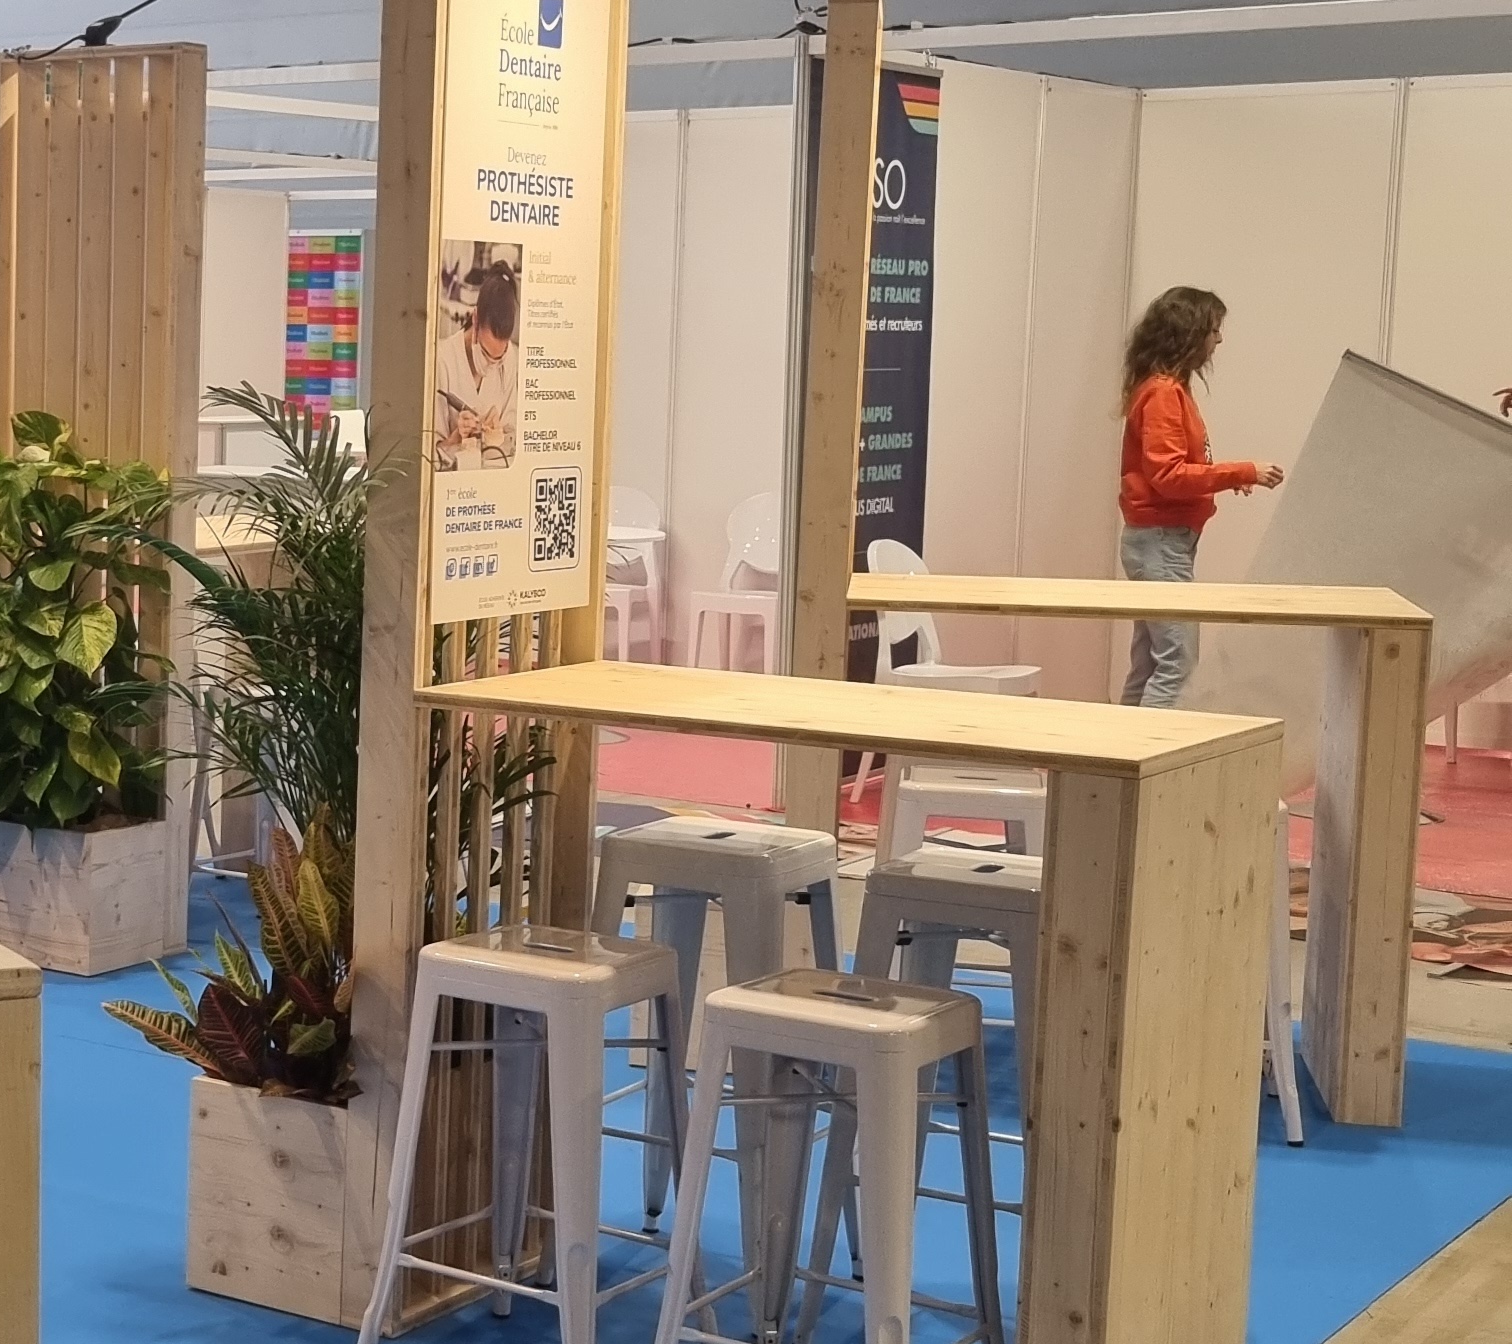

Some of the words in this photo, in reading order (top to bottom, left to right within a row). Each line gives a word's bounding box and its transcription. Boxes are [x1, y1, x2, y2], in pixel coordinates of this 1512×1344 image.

[500, 13, 534, 46] École
[499, 48, 561, 81] Dentaire
[497, 82, 560, 118] Française
[507, 146, 547, 166] Devenez
[477, 167, 574, 199] PROTHÉSISTE
[490, 200, 560, 227] DENTAIRE
[870, 254, 905, 275] RÉSEAU
[908, 259, 929, 276] PRO
[869, 286, 882, 303] DE
[884, 286, 922, 304] FRANCE
[526, 346, 544, 356] TITRE
[526, 358, 577, 369] PROFESSIONNEL
[525, 378, 539, 389] BAC
[524, 390, 576, 401] PROFESSIONNEL
[524, 410, 537, 421] BTS
[868, 432, 913, 451] GRANDES
[866, 463, 902, 482] FRANCE
[445, 506, 456, 517] DE
[457, 501, 496, 517] PROTHÈSE
[866, 496, 894, 515] DIGITAL
[445, 520, 482, 534] DENTAIRE
[483, 520, 493, 531] DE
[494, 518, 523, 531] FRANCE
